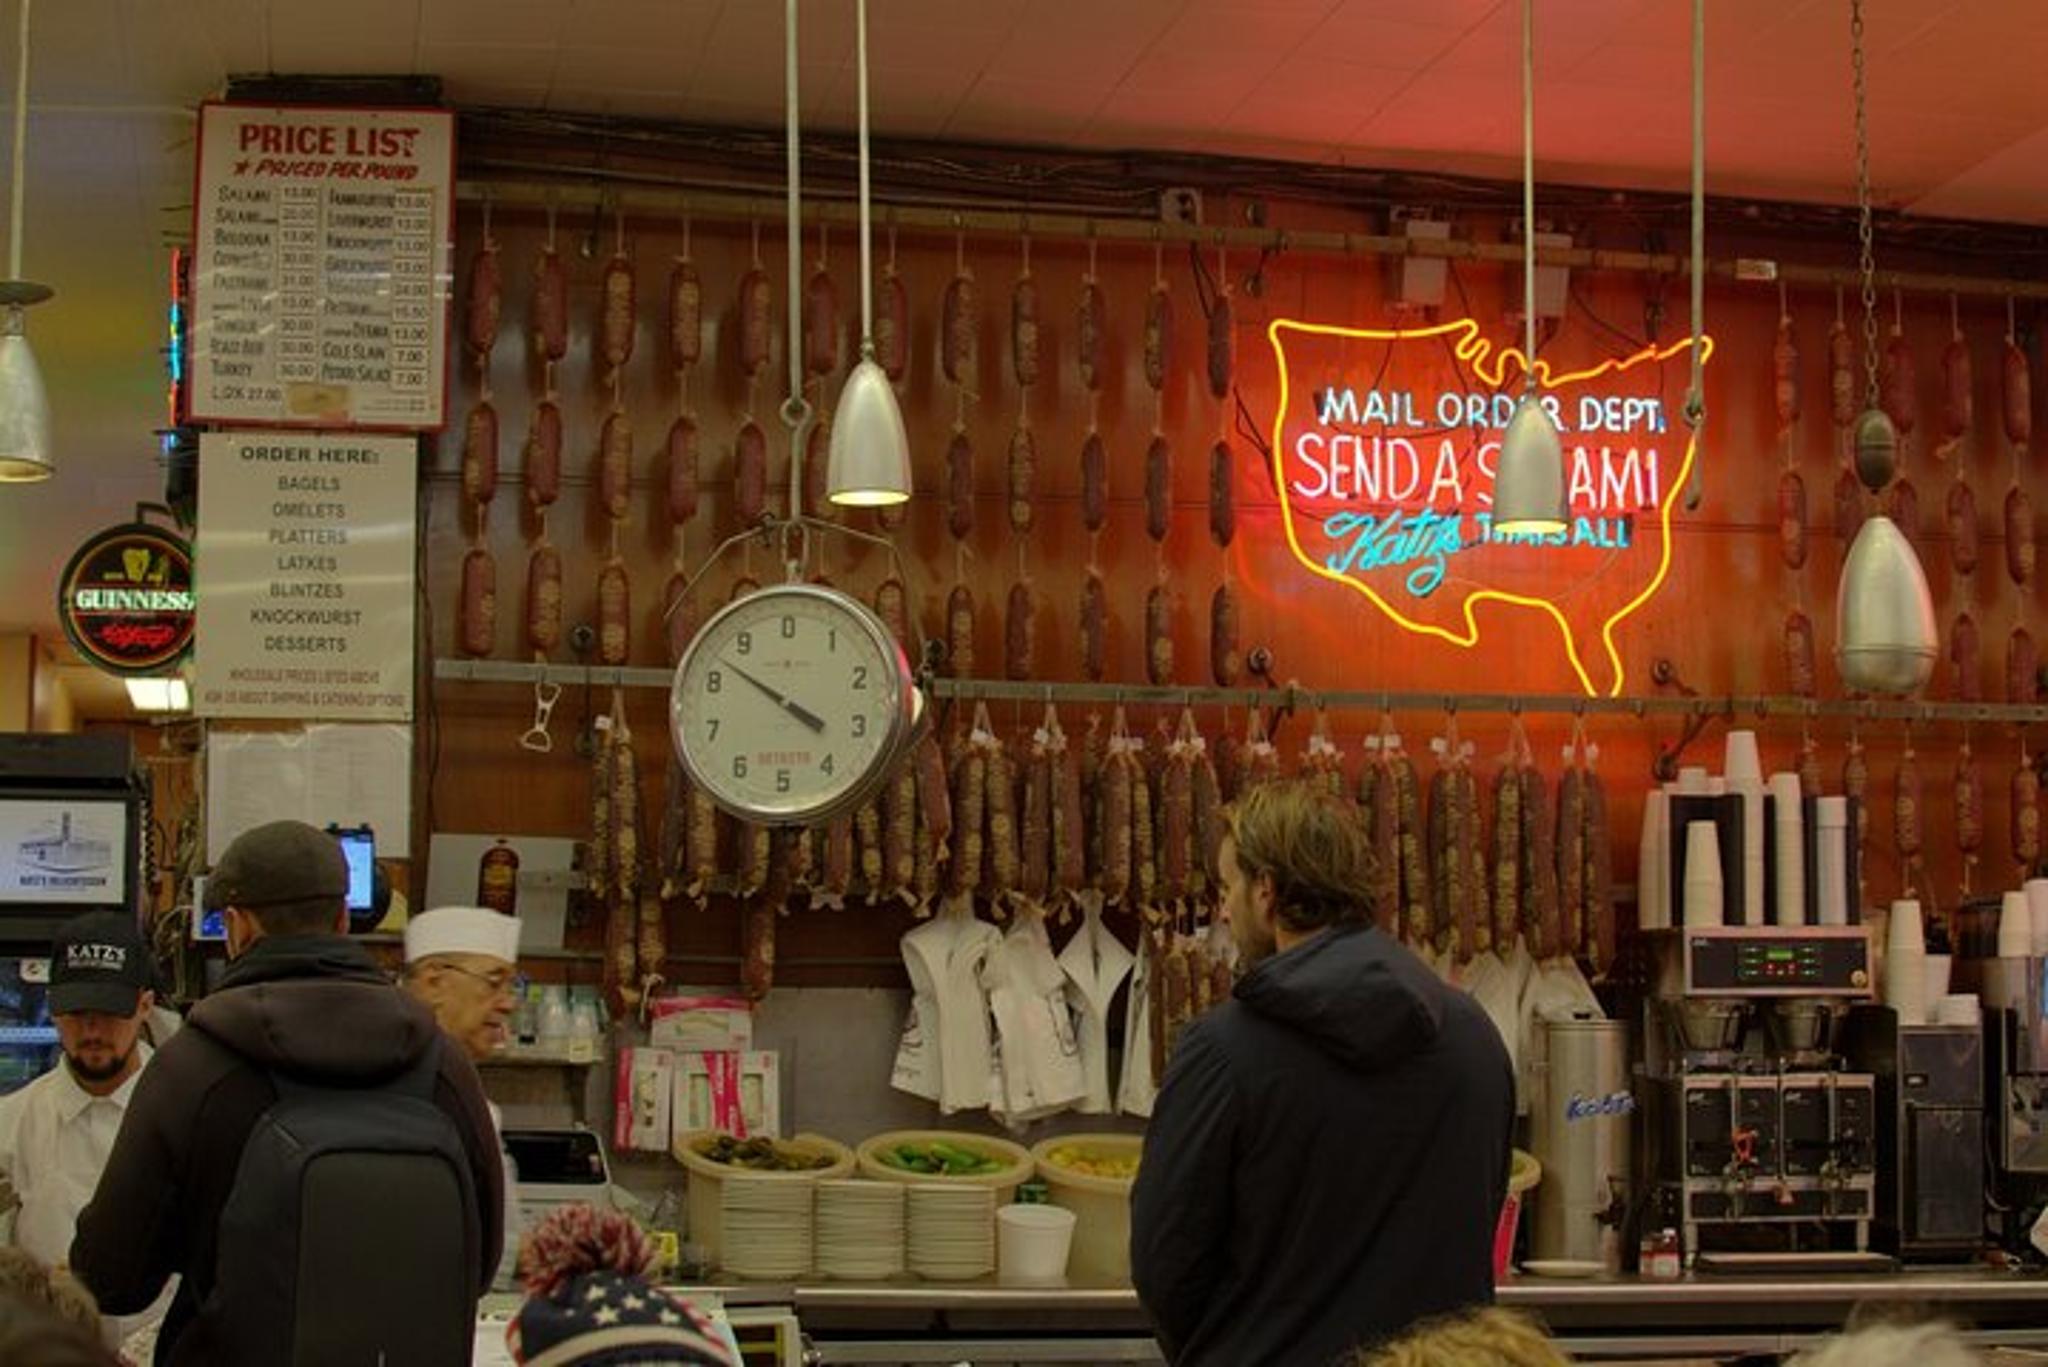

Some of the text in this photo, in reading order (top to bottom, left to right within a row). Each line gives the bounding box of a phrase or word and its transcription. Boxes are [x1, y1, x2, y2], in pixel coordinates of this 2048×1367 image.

[240, 124, 420, 157] PRICE LIST
[256, 159, 418, 180] PRICED PER POUND
[396, 351, 423, 362] 7.00
[396, 373, 423, 385] 7.00
[1319, 387, 1666, 434] MAIL ORDR DEPT.
[240, 446, 379, 464] ORDER HERE:
[1293, 432, 1420, 501] SEND
[1429, 438, 1463, 505] A
[278, 475, 341, 492] BAGELS
[272, 502, 346, 519] OMELETS
[269, 529, 348, 545] PLATTERS
[1573, 516, 1631, 548] ALL
[277, 556, 338, 572] LATKES
[76, 588, 196, 612] GUINNESS
[270, 582, 343, 599] BLINTZES
[250, 608, 363, 626] KNOCKWURST
[781, 615, 796, 639] 0
[264, 635, 348, 652] DESSERTS
[736, 631, 752, 655] 9
[828, 629, 837, 652] 1
[706, 671, 722, 694] 8
[852, 666, 867, 690] 2
[706, 719, 720, 742] 7
[851, 714, 867, 738] 3
[733, 756, 748, 779] 6
[820, 753, 834, 776] 4
[776, 769, 790, 793] 5
[67, 943, 127, 961] KATZ'S
